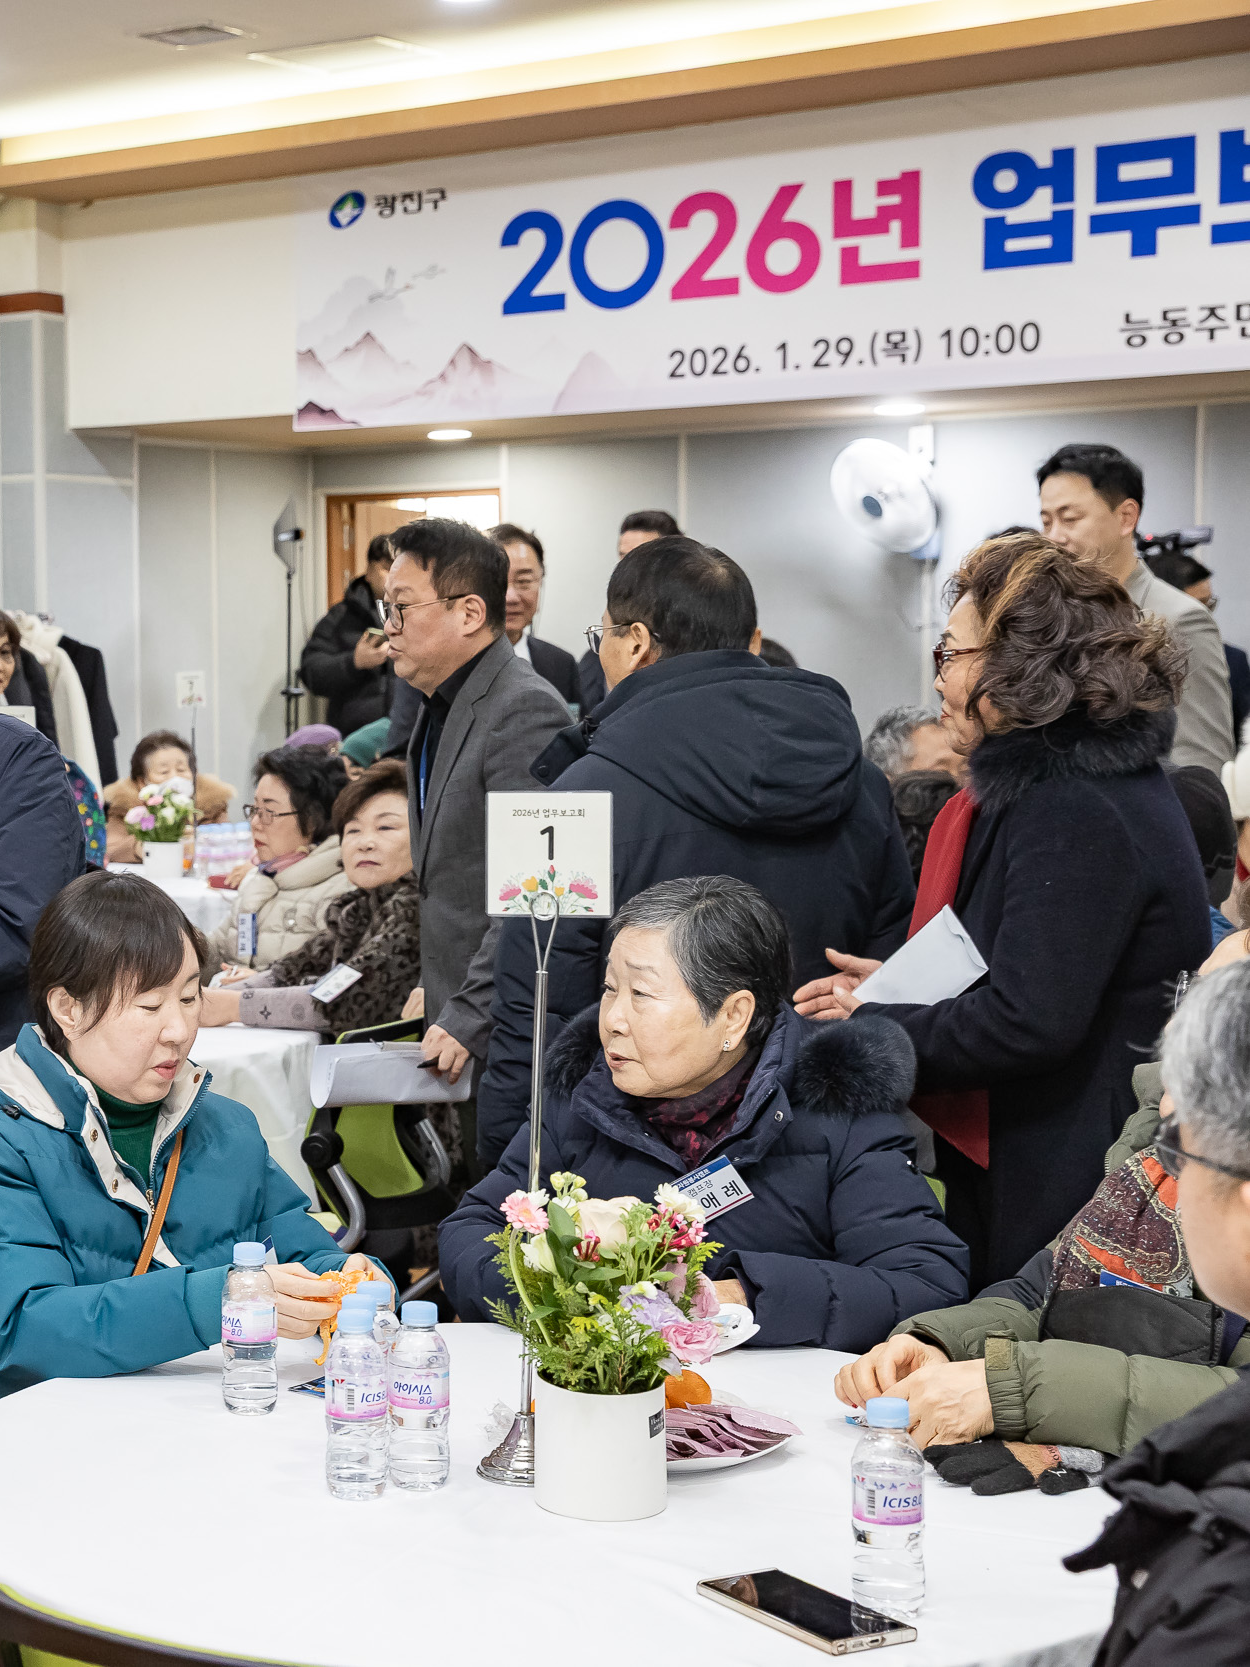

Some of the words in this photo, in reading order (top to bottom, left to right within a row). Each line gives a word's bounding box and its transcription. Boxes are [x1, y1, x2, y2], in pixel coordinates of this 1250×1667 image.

[374, 187, 447, 219] 광진구
[501, 169, 923, 316] 2026년
[668, 344, 761, 379] 2026.
[775, 341, 801, 371] 1.
[812, 329, 923, 368] 29.(목)
[940, 321, 1042, 359] 10:00
[512, 808, 540, 819] 2026년
[542, 808, 586, 819] 업무보고회
[540, 825, 554, 861] 1
[393, 1381, 433, 1396] 아이시스
[418, 1395, 433, 1406] 8.0
